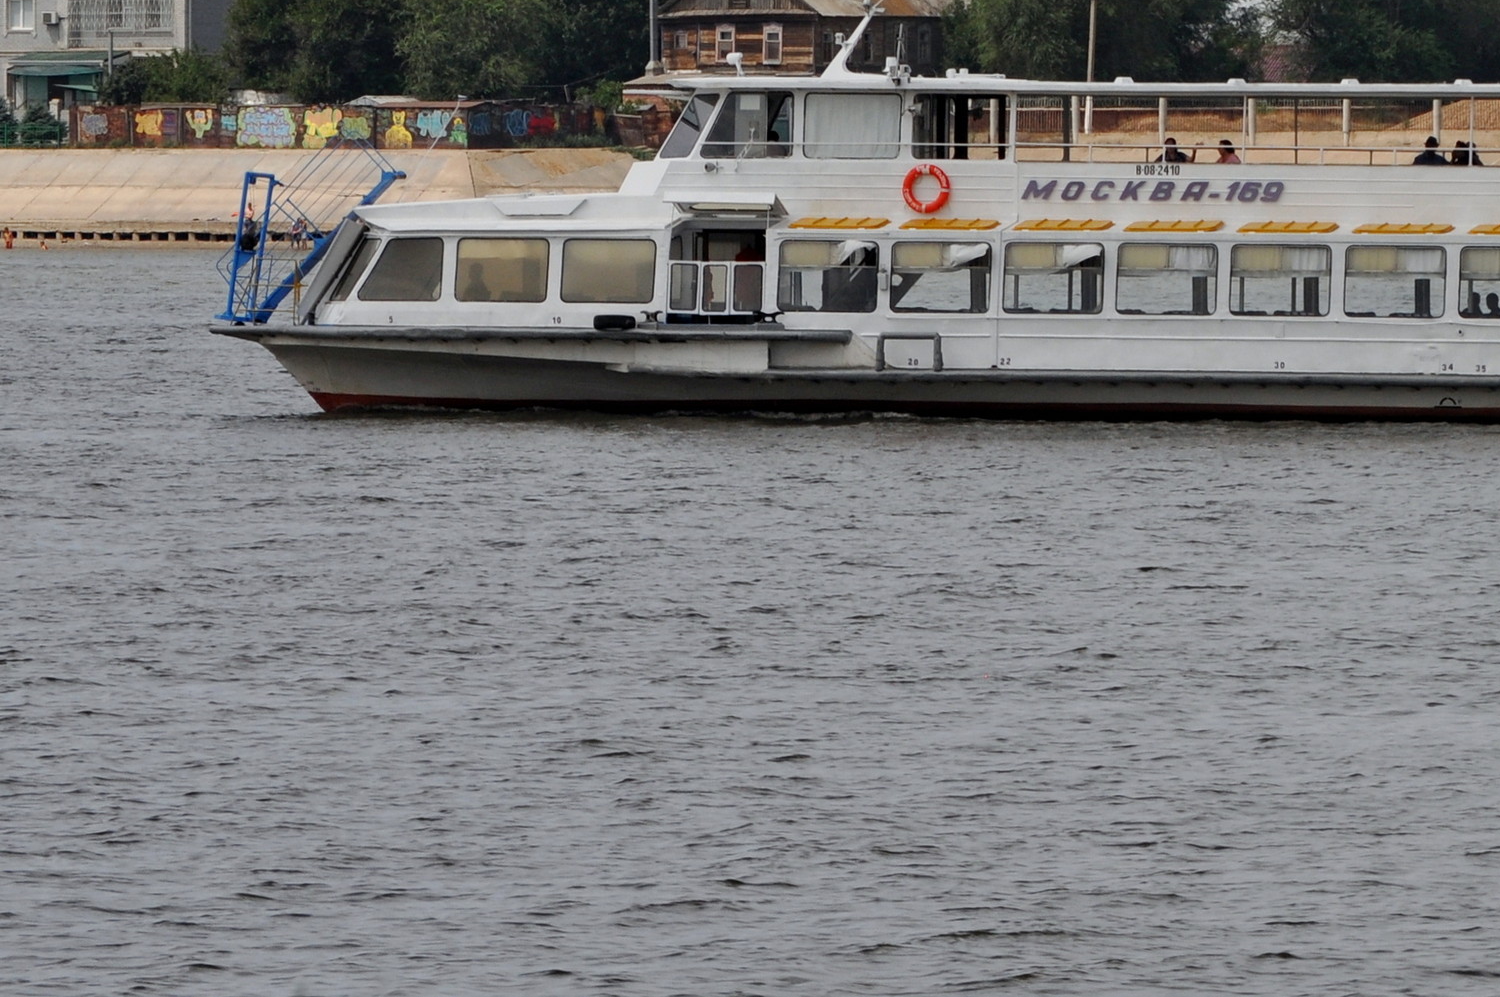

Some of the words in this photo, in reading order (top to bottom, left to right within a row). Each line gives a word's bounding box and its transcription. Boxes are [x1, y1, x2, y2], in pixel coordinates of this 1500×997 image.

[1020, 179, 1286, 203] МОСКВА-169
[552, 316, 562, 324] 10
[1000, 357, 1012, 365] 22
[1441, 363, 1454, 372] 34
